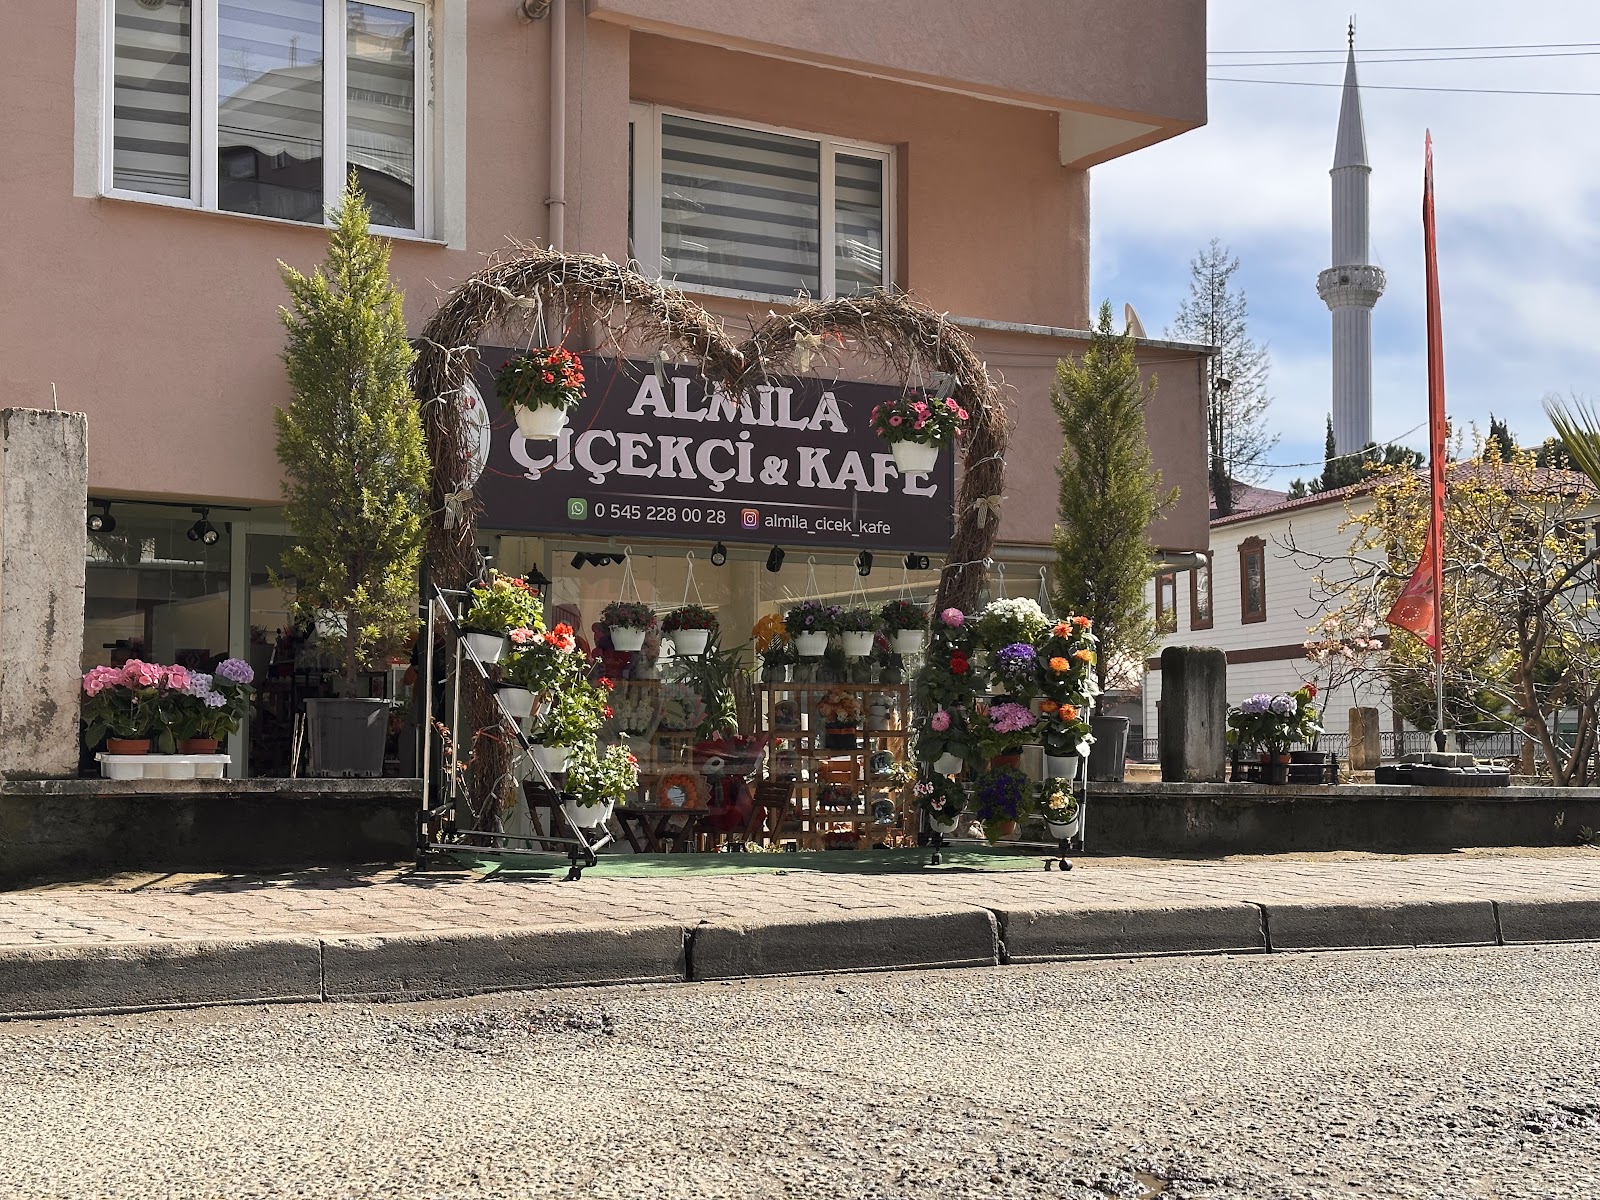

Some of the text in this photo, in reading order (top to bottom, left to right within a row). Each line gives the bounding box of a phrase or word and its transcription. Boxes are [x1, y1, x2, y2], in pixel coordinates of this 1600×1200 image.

[759, 455, 789, 486] &
[796, 446, 938, 499] KAFE
[594, 502, 727, 525] 0 545 228 00 28
[764, 513, 891, 537] almila_cicek_kafe
